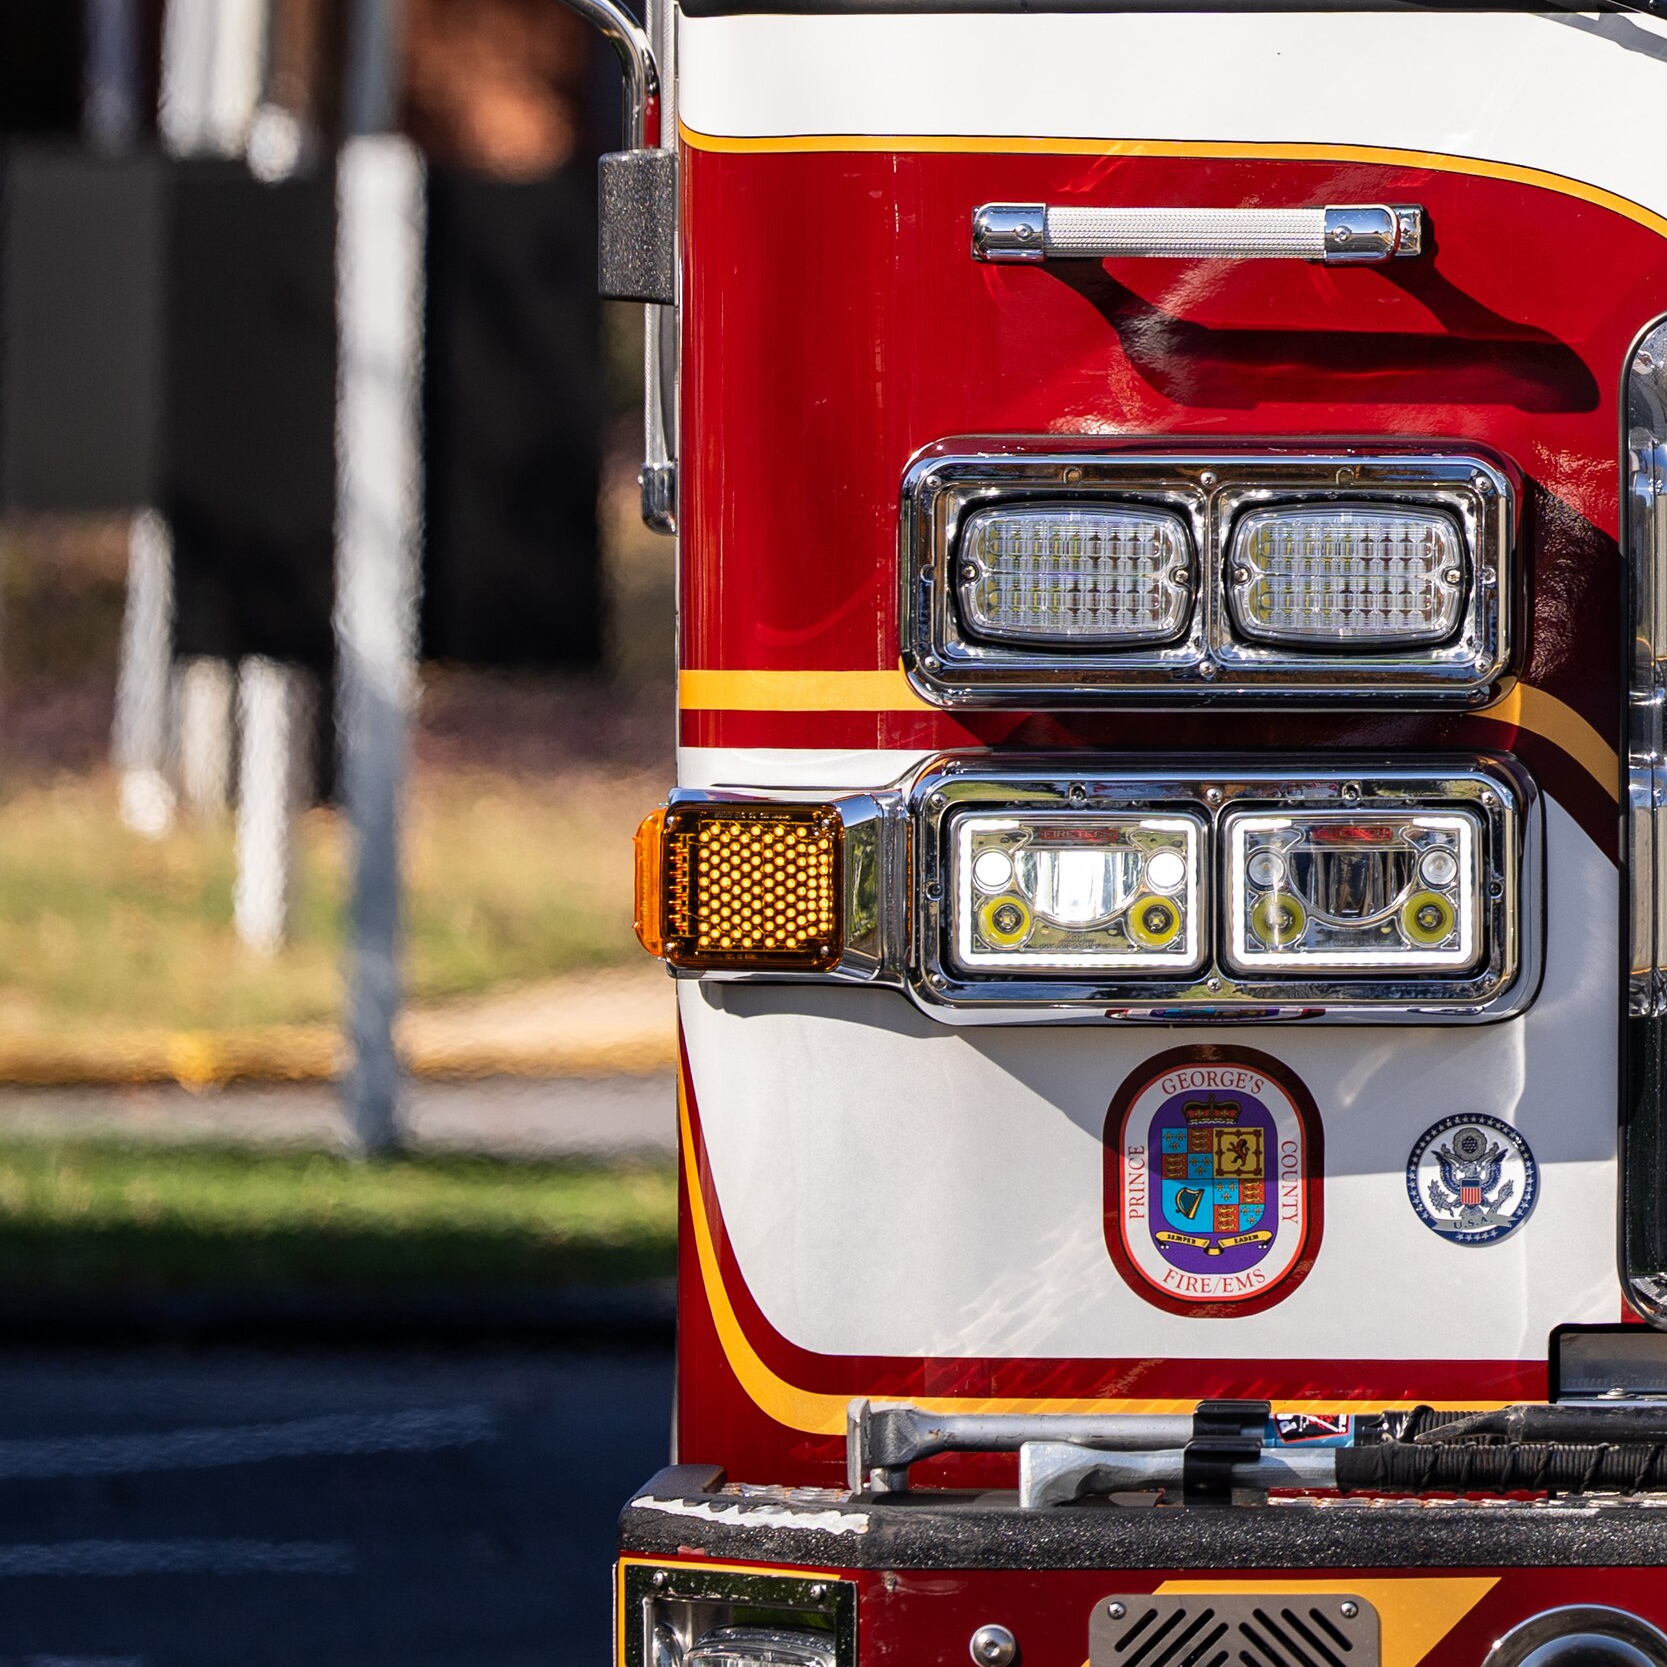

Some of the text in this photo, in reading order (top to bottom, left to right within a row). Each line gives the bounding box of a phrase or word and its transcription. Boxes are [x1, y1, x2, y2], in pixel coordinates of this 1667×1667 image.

[1161, 1070, 1266, 1097] GEORGE'S
[1127, 1144, 1146, 1221] PRINCE
[1279, 1140, 1298, 1225] COUNTY
[1453, 1216, 1494, 1230] U.S.A.
[1162, 1268, 1268, 1295] FIRE/EMS
